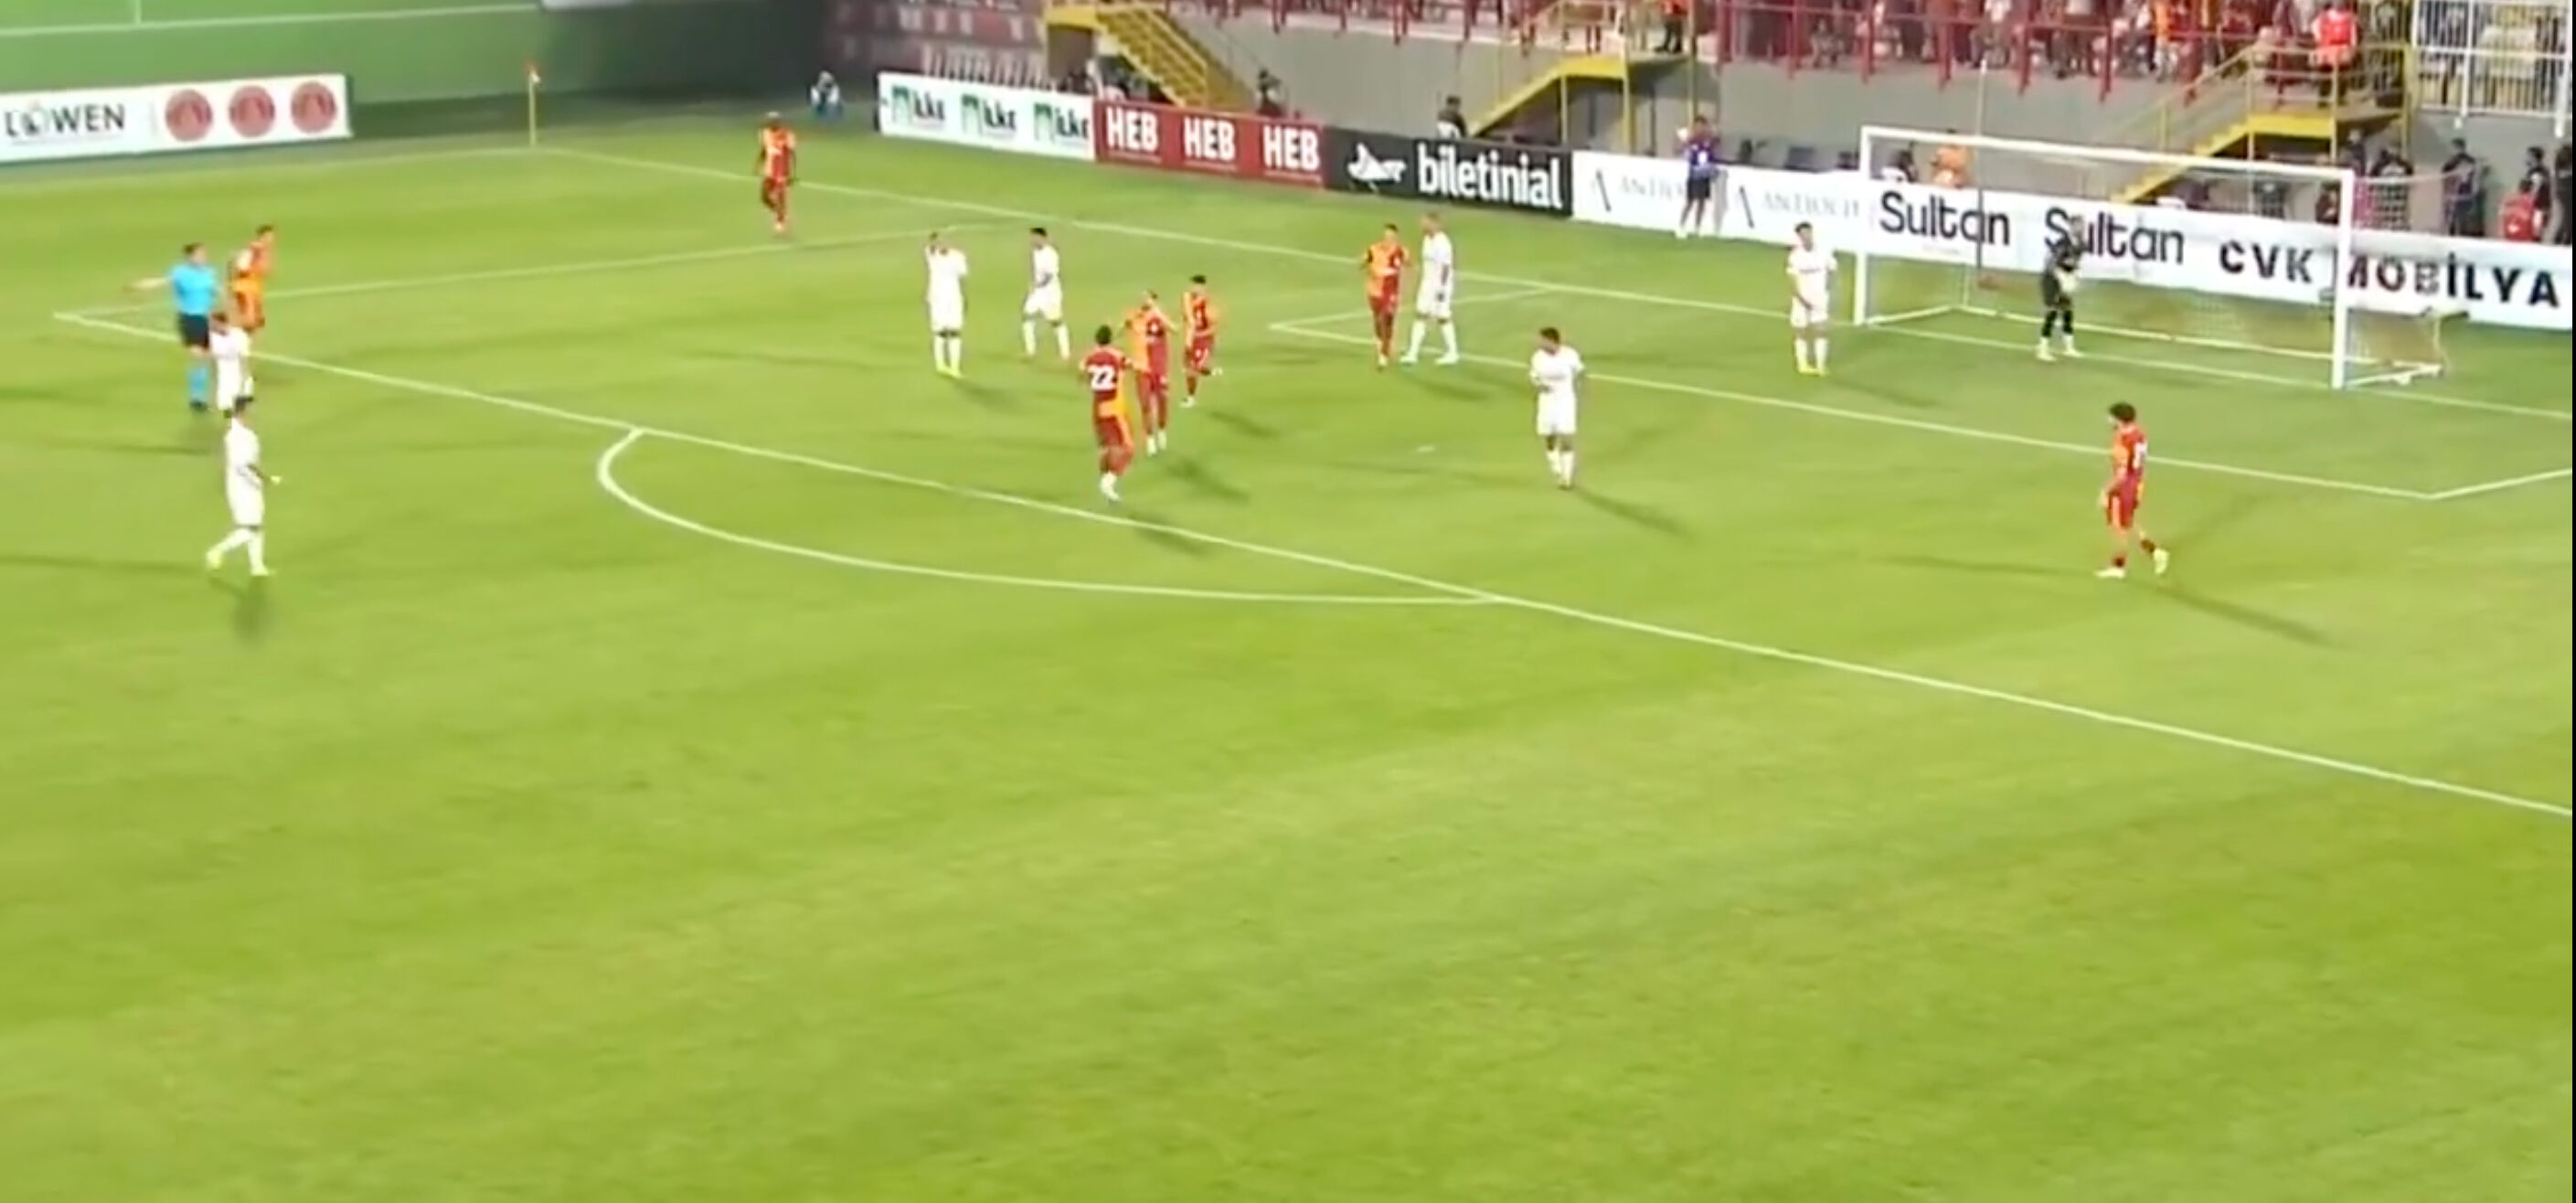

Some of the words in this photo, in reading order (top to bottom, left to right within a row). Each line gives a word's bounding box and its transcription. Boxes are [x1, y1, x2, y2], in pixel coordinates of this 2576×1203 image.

[1106, 106, 1158, 152] HEB
[1184, 116, 1235, 161] HEB
[1263, 124, 1320, 171] HEB
[1418, 143, 1564, 209] biletinial
[1879, 191, 2010, 246] Sultan
[2219, 240, 2315, 283] CVK
[1088, 364, 1115, 391] 22
